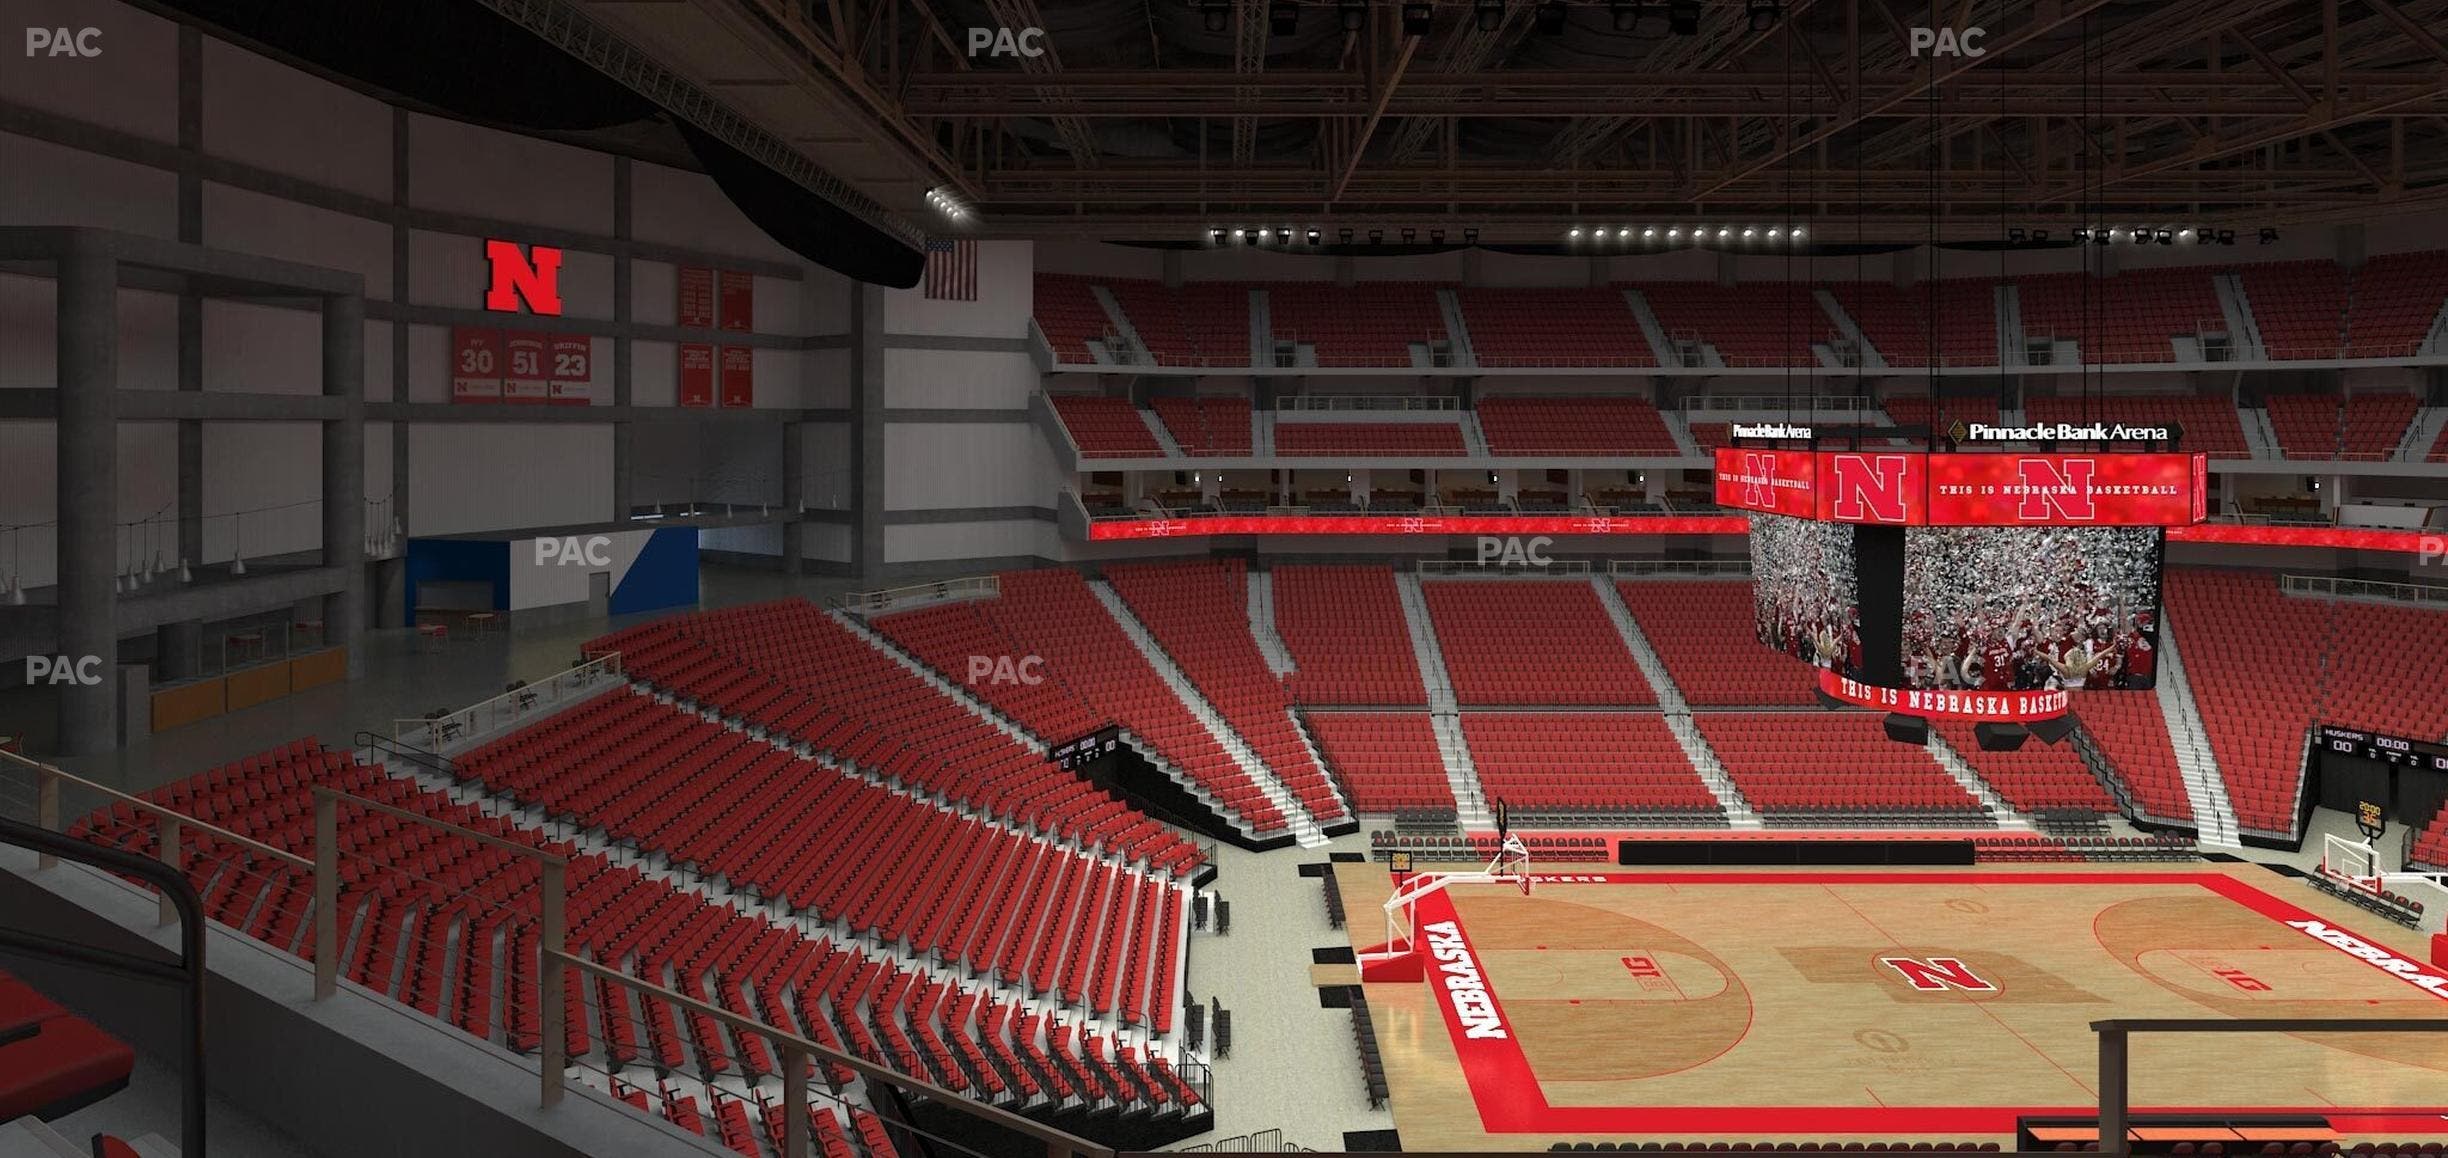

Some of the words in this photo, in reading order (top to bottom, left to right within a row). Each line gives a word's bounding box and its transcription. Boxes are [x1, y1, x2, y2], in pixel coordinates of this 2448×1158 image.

[486, 239, 562, 316] N
[462, 349, 494, 374] 30
[512, 350, 539, 376] 51
[554, 353, 586, 377] 23
[1969, 423, 2056, 441] Pinnacle
[2057, 423, 2109, 441] Bank
[2107, 423, 2168, 441] Arena
[1745, 453, 1775, 508] N
[1835, 455, 1906, 522] N
[1939, 485, 1973, 495] THIS
[1981, 485, 1995, 495] IS
[2003, 485, 2077, 495] NEBRASKA
[2087, 485, 2178, 495] BASKETBALL
[2018, 459, 2095, 520] N
[1840, 678, 1871, 700] THIS
[1881, 687, 1897, 705] IS
[1909, 690, 2010, 715] NEBRASKA
[2325, 729, 2363, 741] HUSKERS
[2333, 740, 2352, 752] 00
[2376, 737, 2409, 751] 00:00
[1423, 920, 1509, 1040] NEBRASKA
[1880, 957, 1998, 991] N
